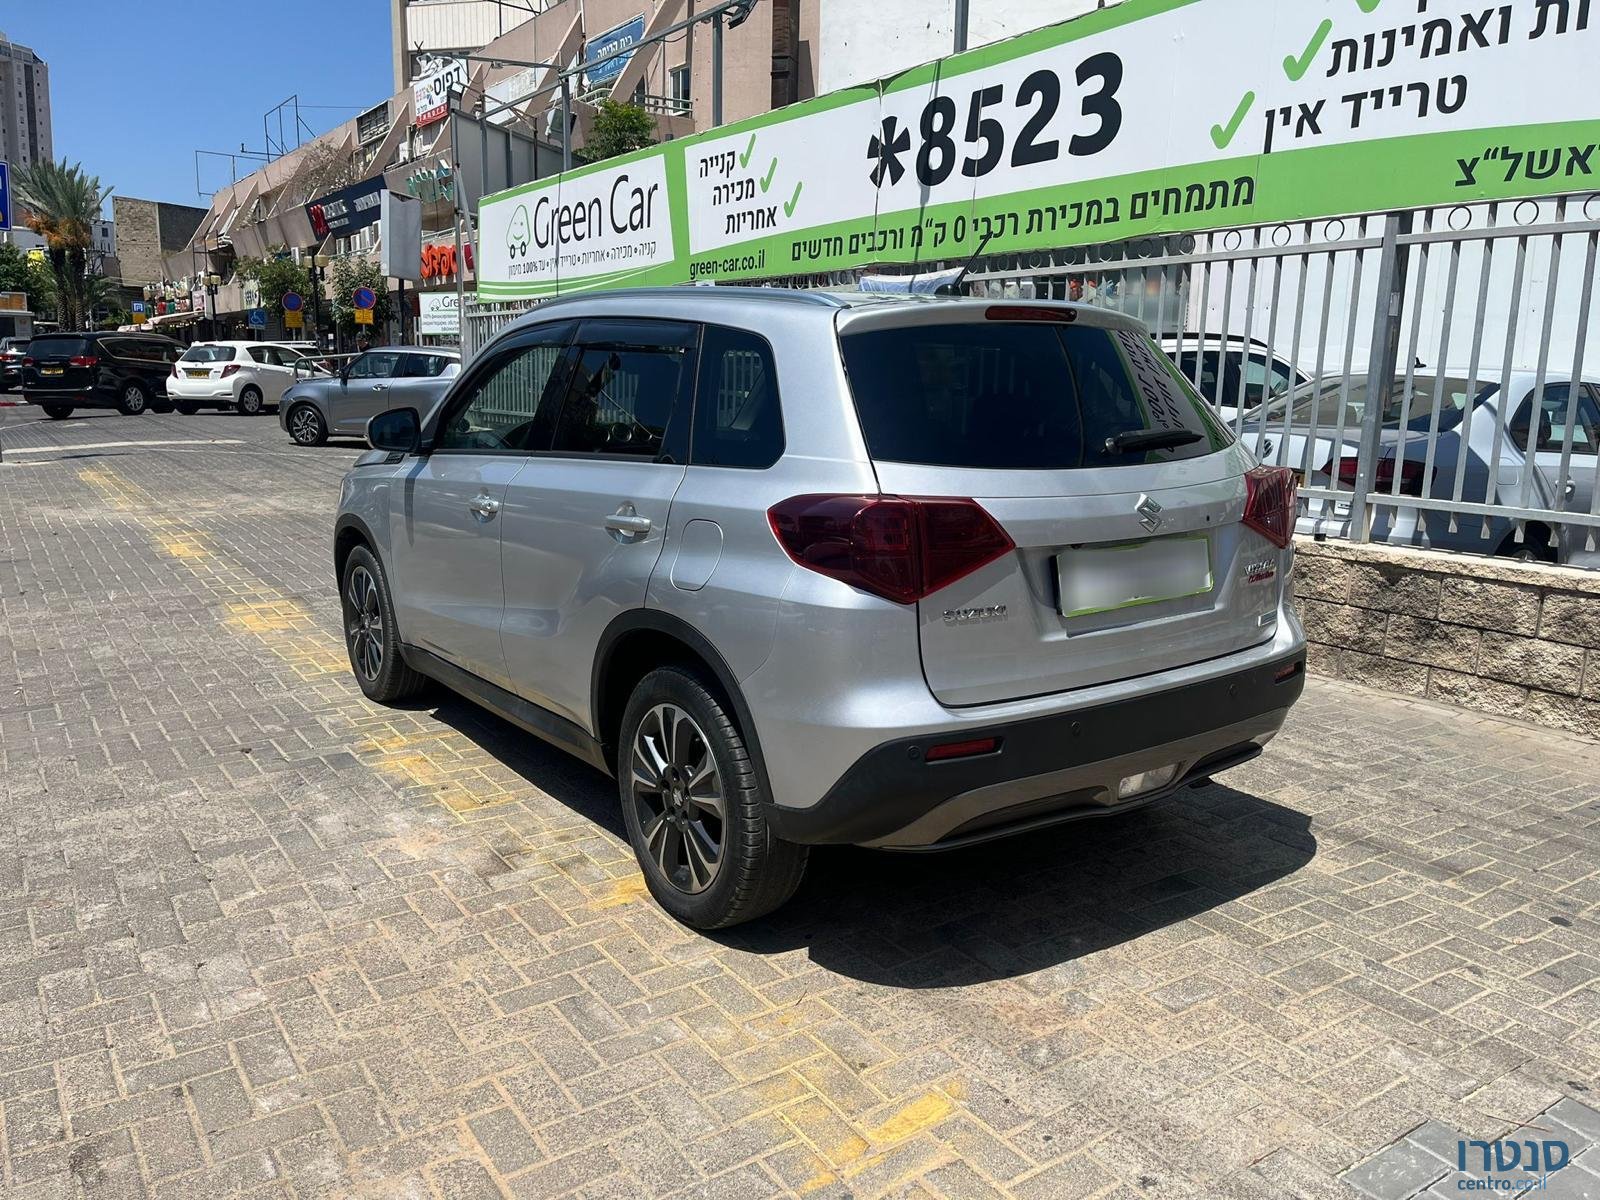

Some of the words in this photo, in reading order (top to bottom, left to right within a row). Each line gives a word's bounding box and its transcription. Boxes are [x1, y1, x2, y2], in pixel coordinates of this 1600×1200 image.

[1327, 5, 1513, 78] ואמינות
[434, 66, 461, 96] דפוס
[1341, 75, 1467, 129] טרייד
[1264, 99, 1326, 154] אין
[699, 150, 735, 179] קנייה
[1455, 144, 1600, 187] אשל"צ
[712, 178, 755, 207] מכירה
[1129, 175, 1254, 220] מתמחים
[534, 196, 602, 249] Green
[609, 174, 659, 235] Car
[725, 204, 778, 235] אחריות
[972, 211, 1019, 242] רכבי
[1028, 196, 1119, 236] במכירת
[848, 225, 905, 254] ורכבים
[953, 214, 966, 243] 0
[581, 249, 605, 265] אחריות
[610, 244, 632, 261] מכירה
[638, 240, 657, 260] קניה
[791, 231, 843, 262] חדשים
[522, 260, 538, 274] 100%
[689, 249, 766, 282] green-car.co.il
[441, 295, 460, 307] Gre
[943, 605, 1007, 621] SUZUKI
